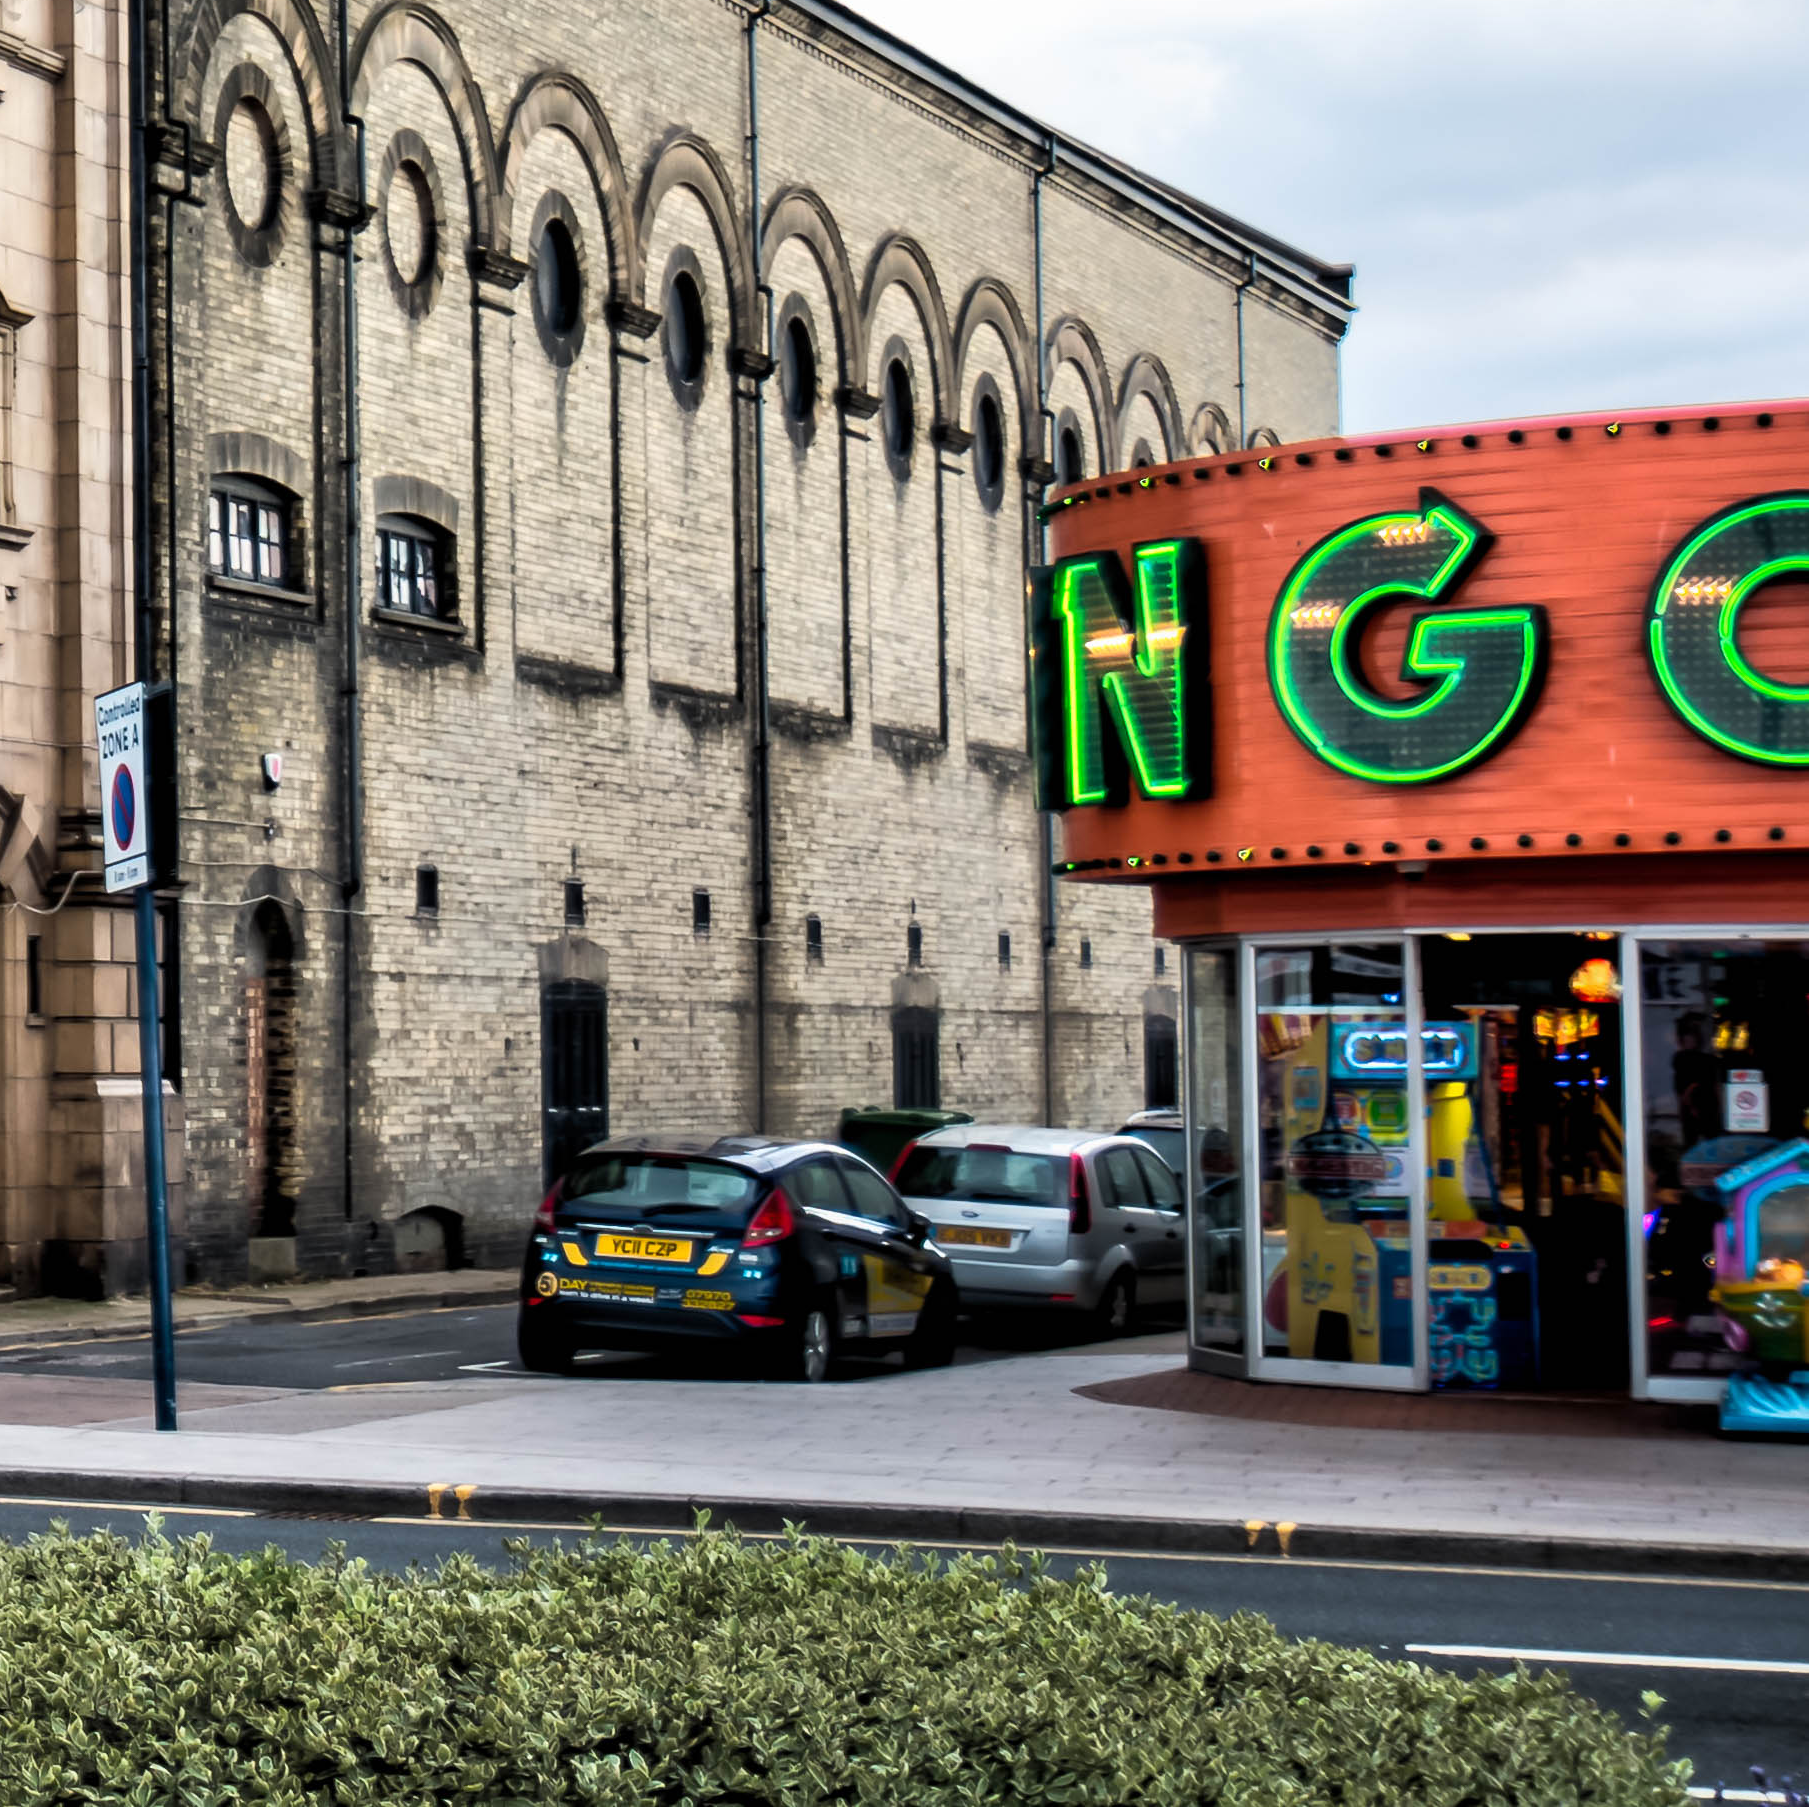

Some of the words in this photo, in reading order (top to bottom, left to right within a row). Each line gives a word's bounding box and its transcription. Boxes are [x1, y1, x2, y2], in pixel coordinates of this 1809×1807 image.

[98, 696, 141, 727] Controlled
[102, 727, 129, 759] ZONE
[132, 723, 140, 747] A
[644, 1240, 678, 1257] CZP
[559, 1277, 588, 1290] DAY
